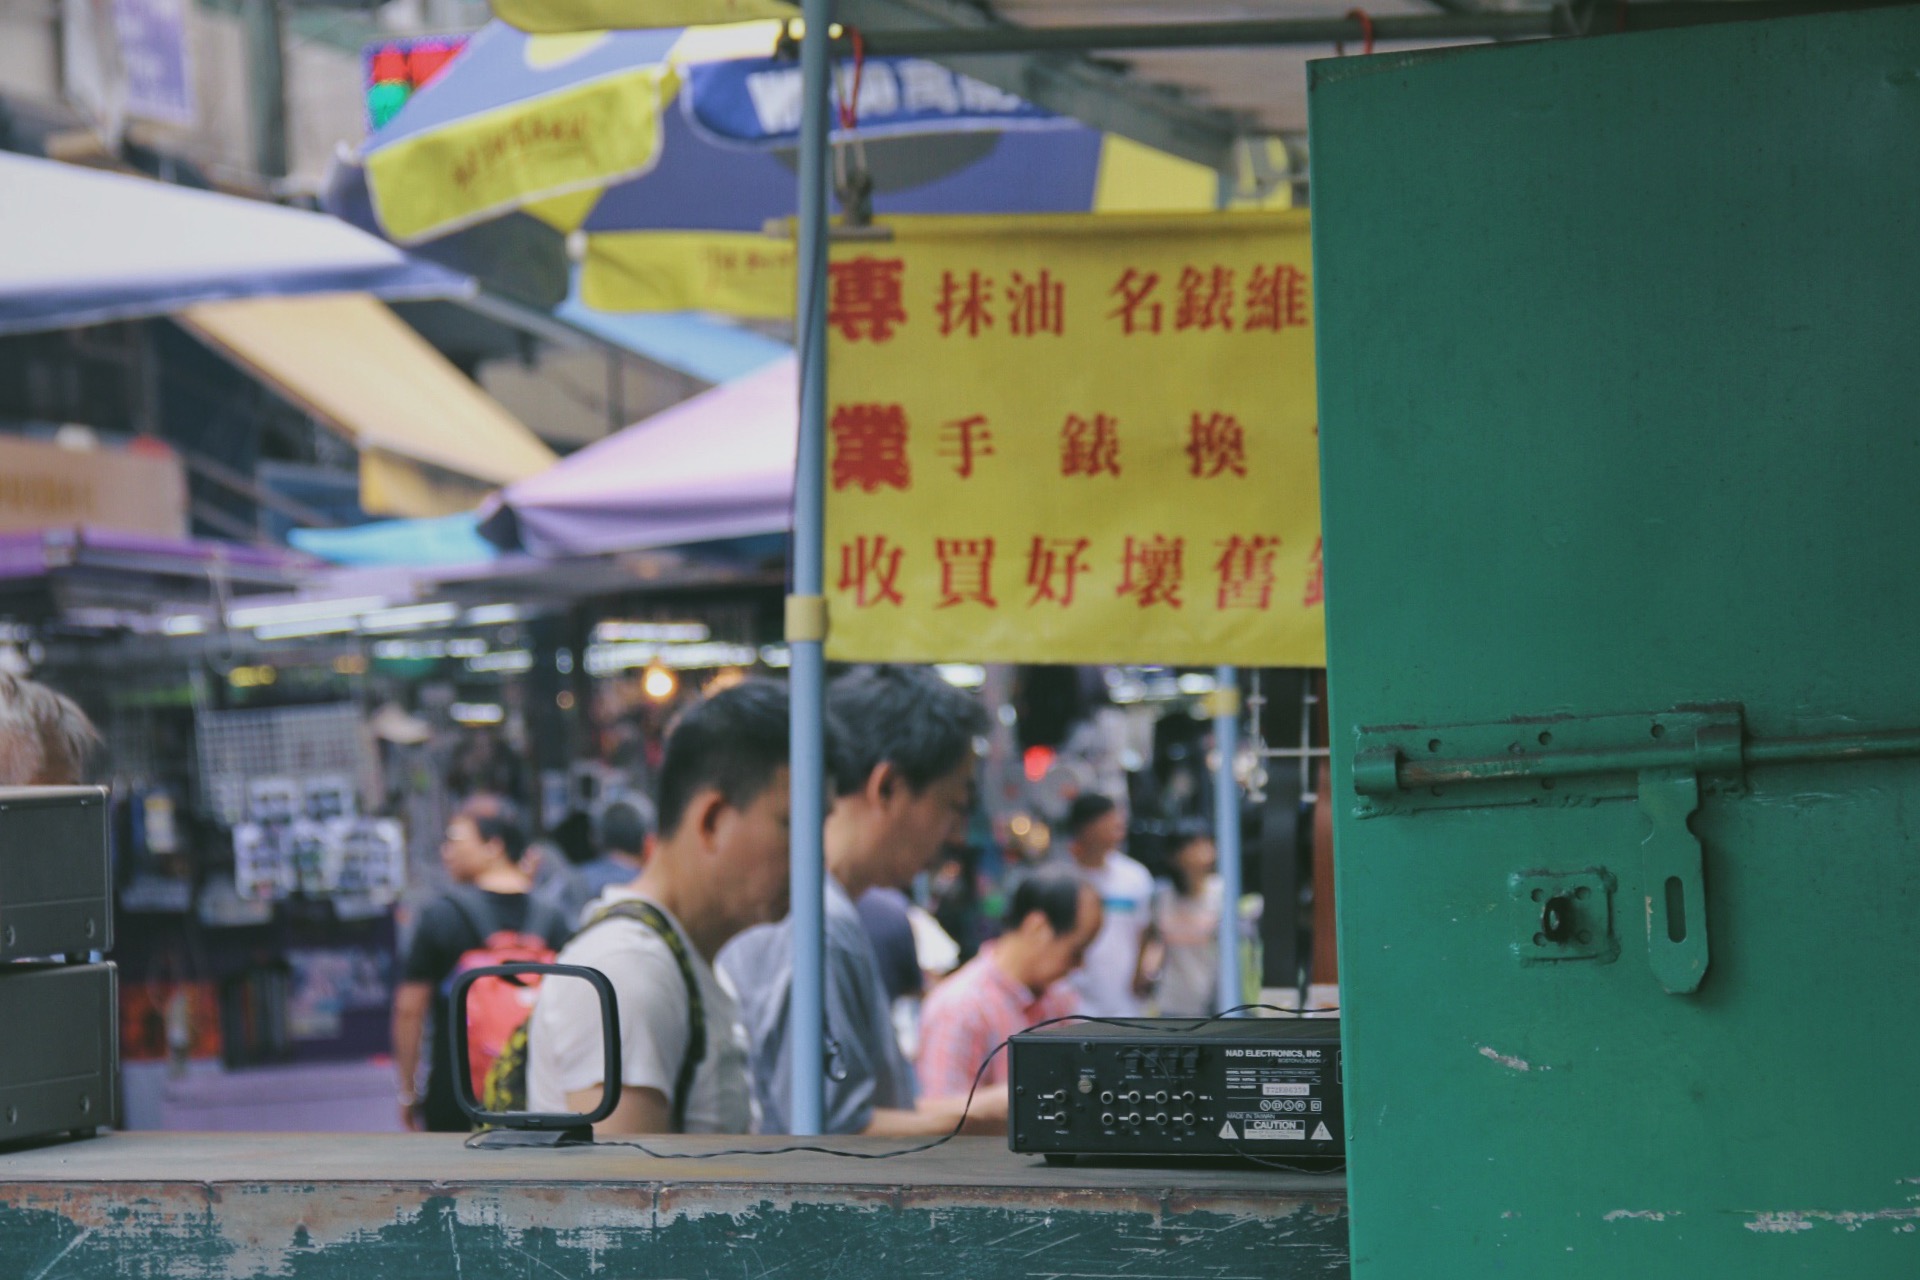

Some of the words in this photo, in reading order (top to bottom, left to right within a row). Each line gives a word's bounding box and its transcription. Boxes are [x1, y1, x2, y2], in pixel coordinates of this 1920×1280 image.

[934, 267, 1067, 338] 抹油
[1107, 263, 1309, 338] 名錶維
[1225, 1049, 1244, 1057] NAD
[1245, 1049, 1305, 1058] ELECTRONICS,
[1306, 1049, 1321, 1057] INC
[1253, 1121, 1296, 1130] CAUTION
